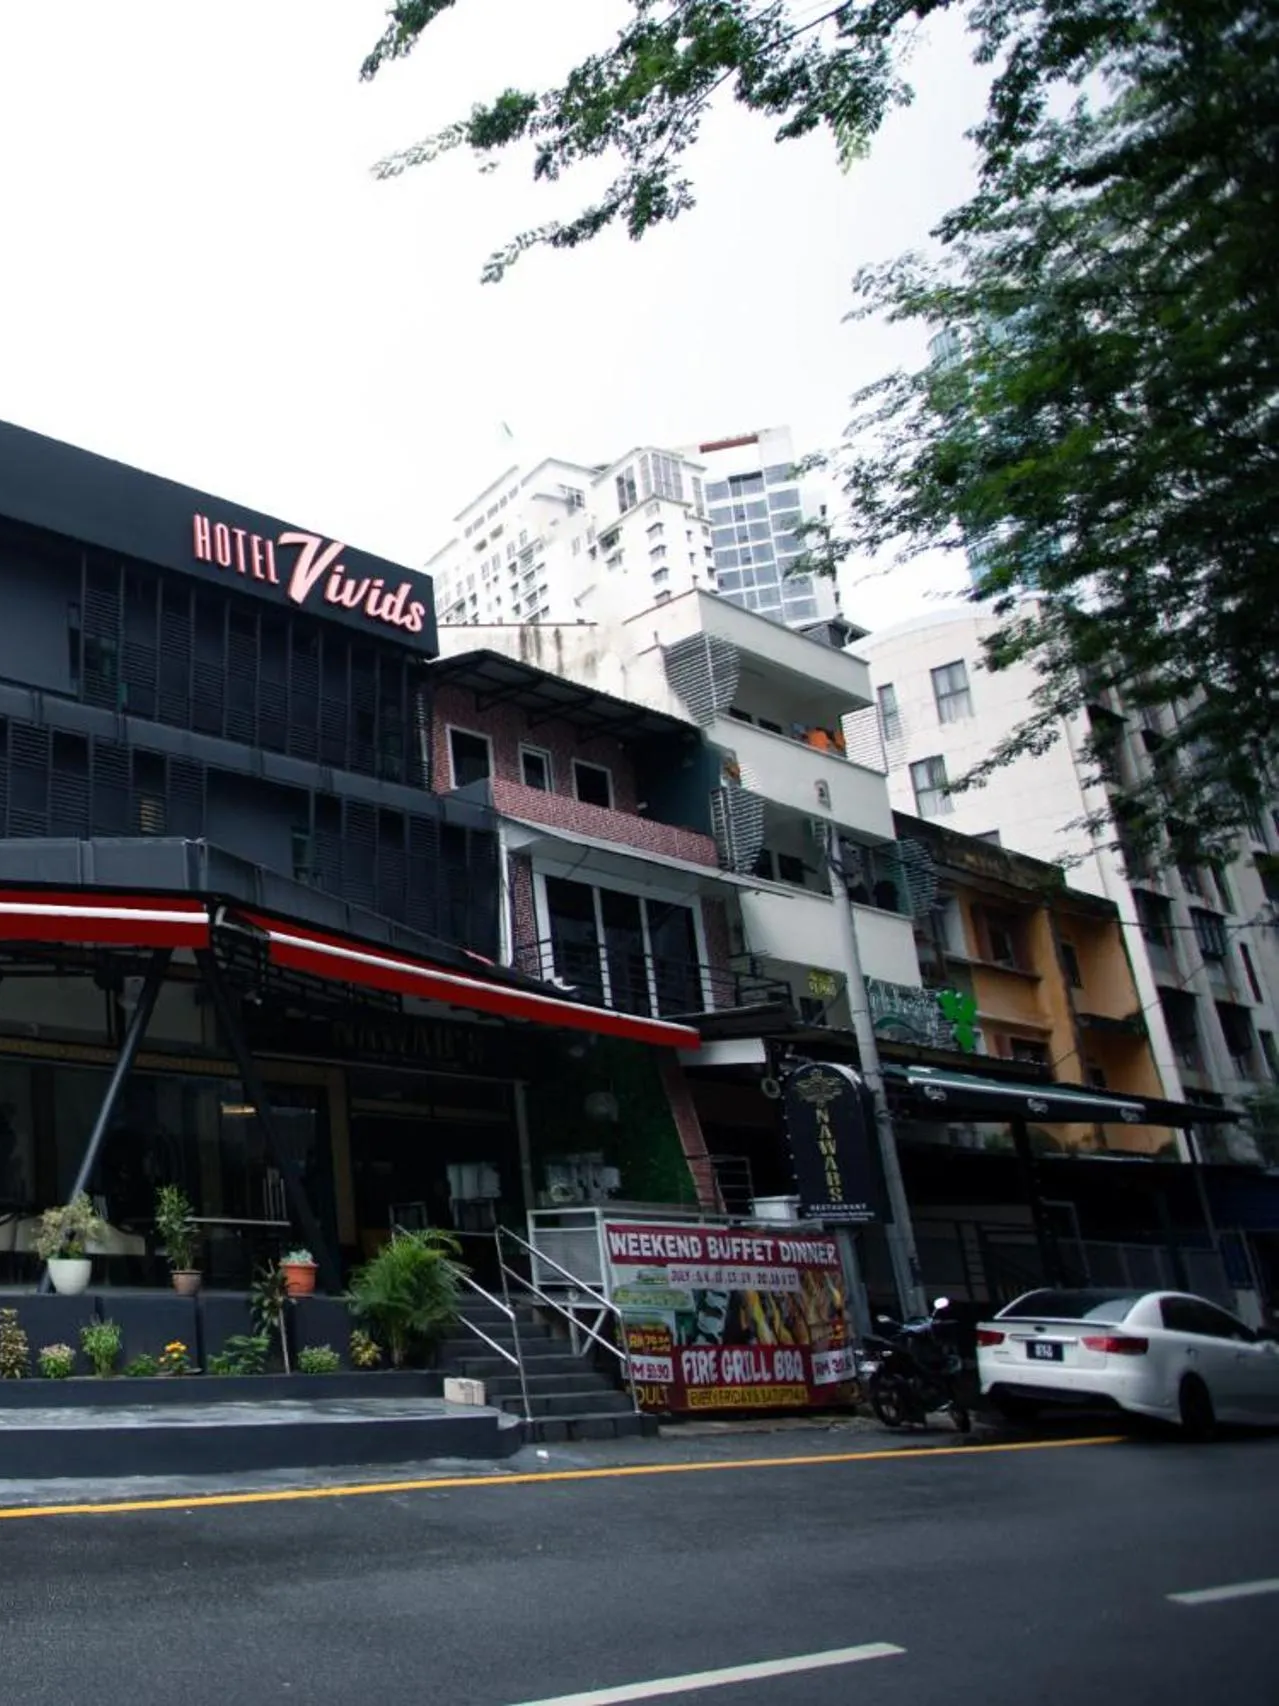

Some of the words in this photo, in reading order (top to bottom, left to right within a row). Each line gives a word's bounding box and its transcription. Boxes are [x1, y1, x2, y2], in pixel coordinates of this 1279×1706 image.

[192, 513, 279, 584] HOTEL
[277, 531, 427, 633] Vivids
[609, 1232, 702, 1259] WEEKEND
[707, 1236, 773, 1262] BUFFET
[780, 1242, 839, 1265] DINNER
[682, 1351, 718, 1384] FIRE
[721, 1350, 771, 1384] GRILL
[774, 1349, 805, 1382] BBQ
